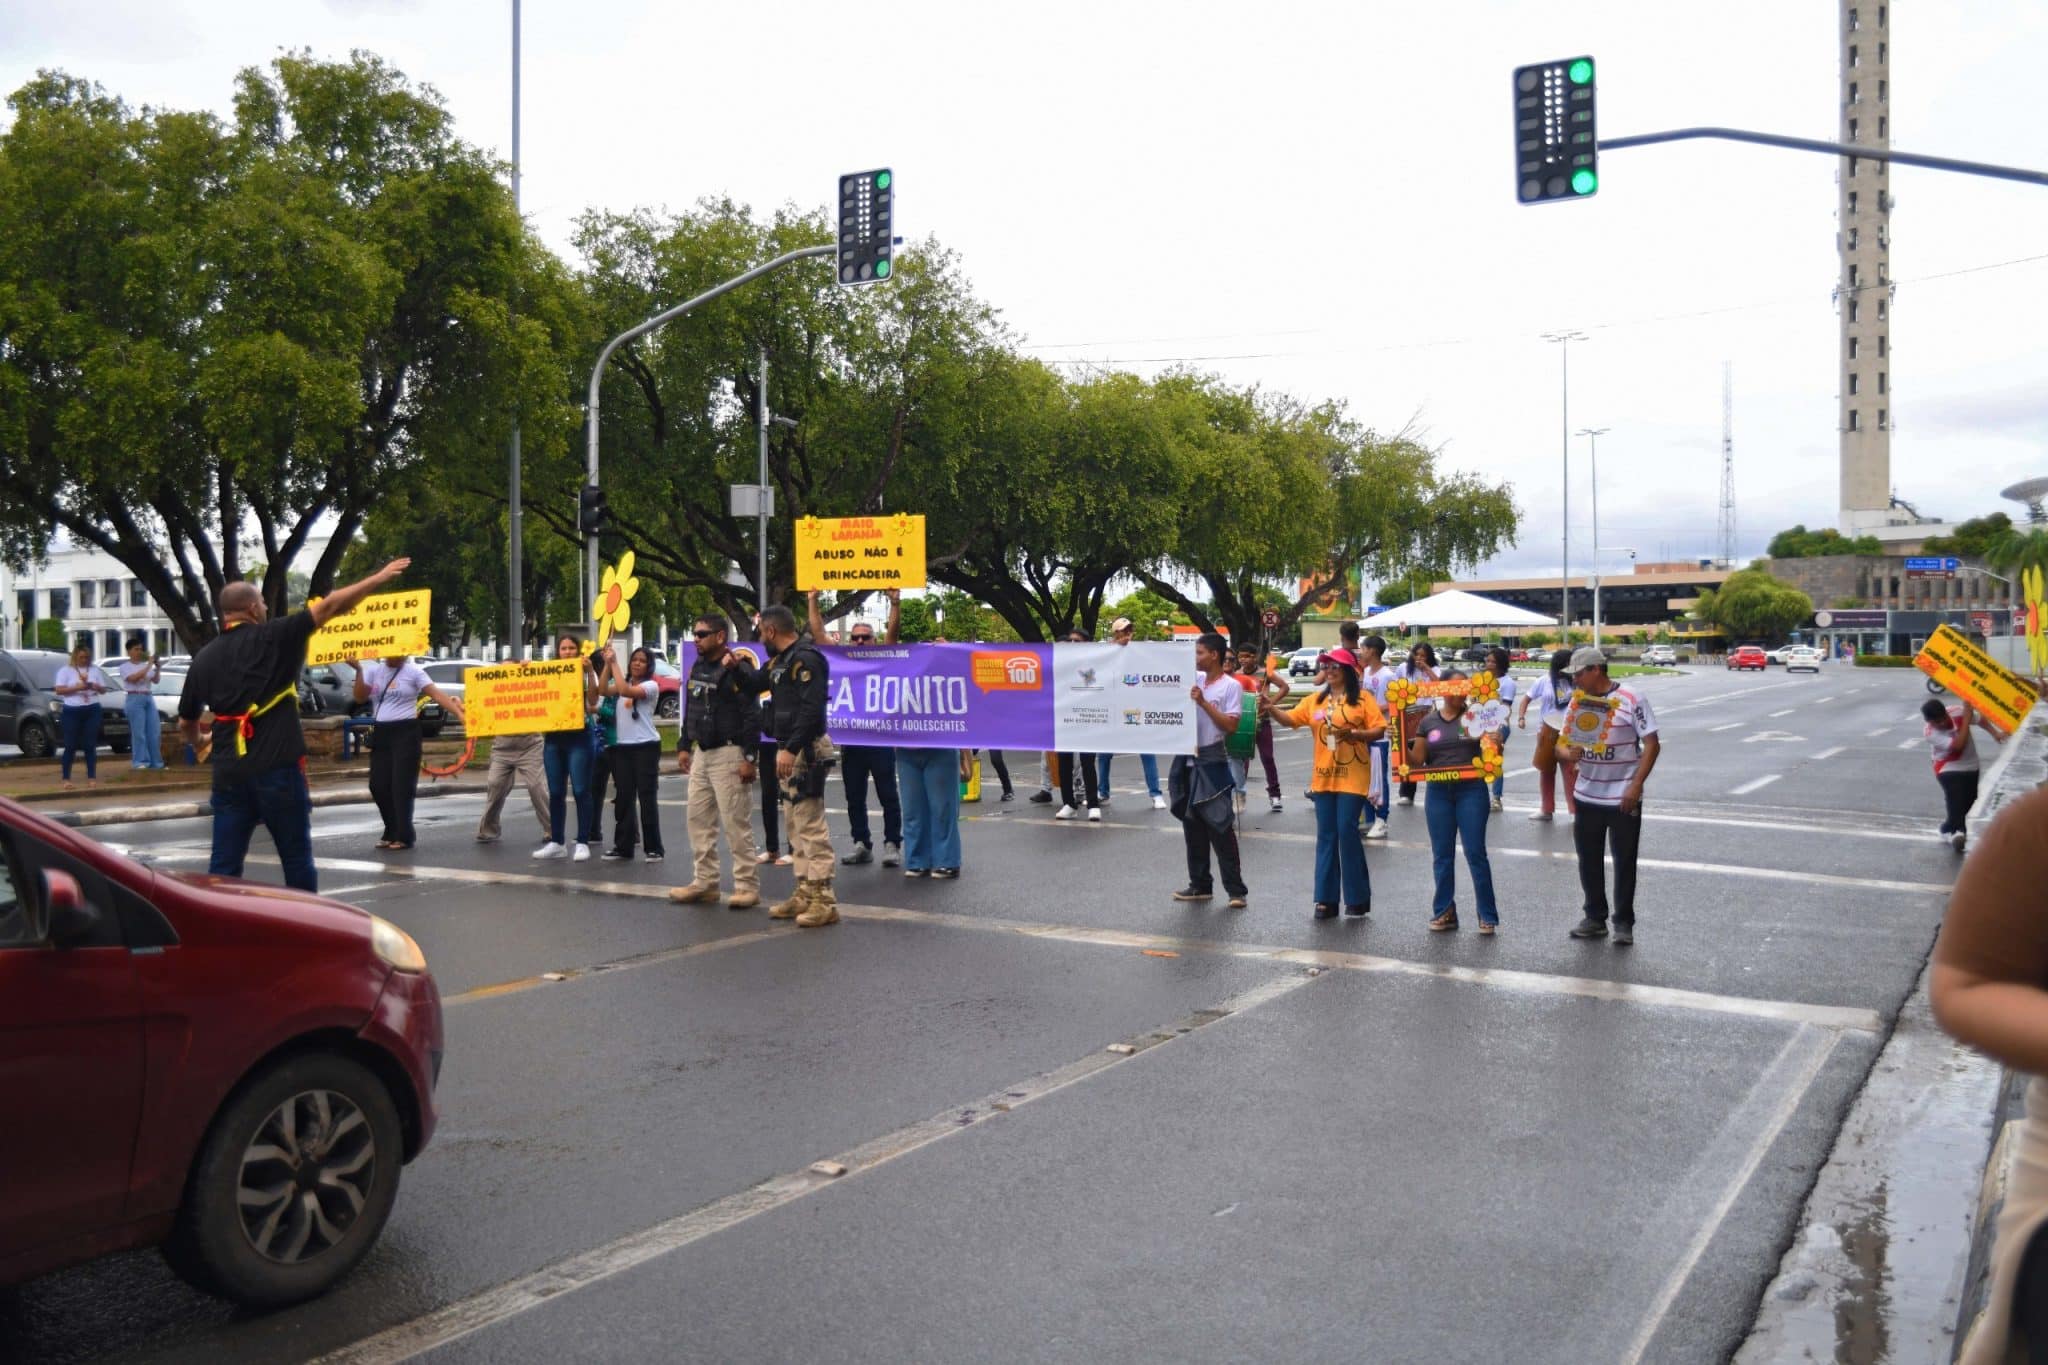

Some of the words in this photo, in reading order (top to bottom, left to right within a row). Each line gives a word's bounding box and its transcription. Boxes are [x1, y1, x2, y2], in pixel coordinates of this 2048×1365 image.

[814, 549, 855, 559] ABUSO
[864, 546, 888, 557] NÃO
[896, 543, 903, 556] É
[822, 569, 901, 580] BRINCADEIRA
[366, 600, 390, 613] NÃO
[320, 623, 364, 635] PECADO
[381, 616, 417, 629] CRIME
[342, 636, 395, 650] DENUNCIE
[1008, 667, 1036, 684] 100
[1142, 674, 1181, 683] CEDCAR
[865, 673, 968, 715] BONITO
[1144, 711, 1184, 720] GOVERNO
[851, 718, 892, 732] CRIANÇAS
[1425, 770, 1460, 781] BONITO
